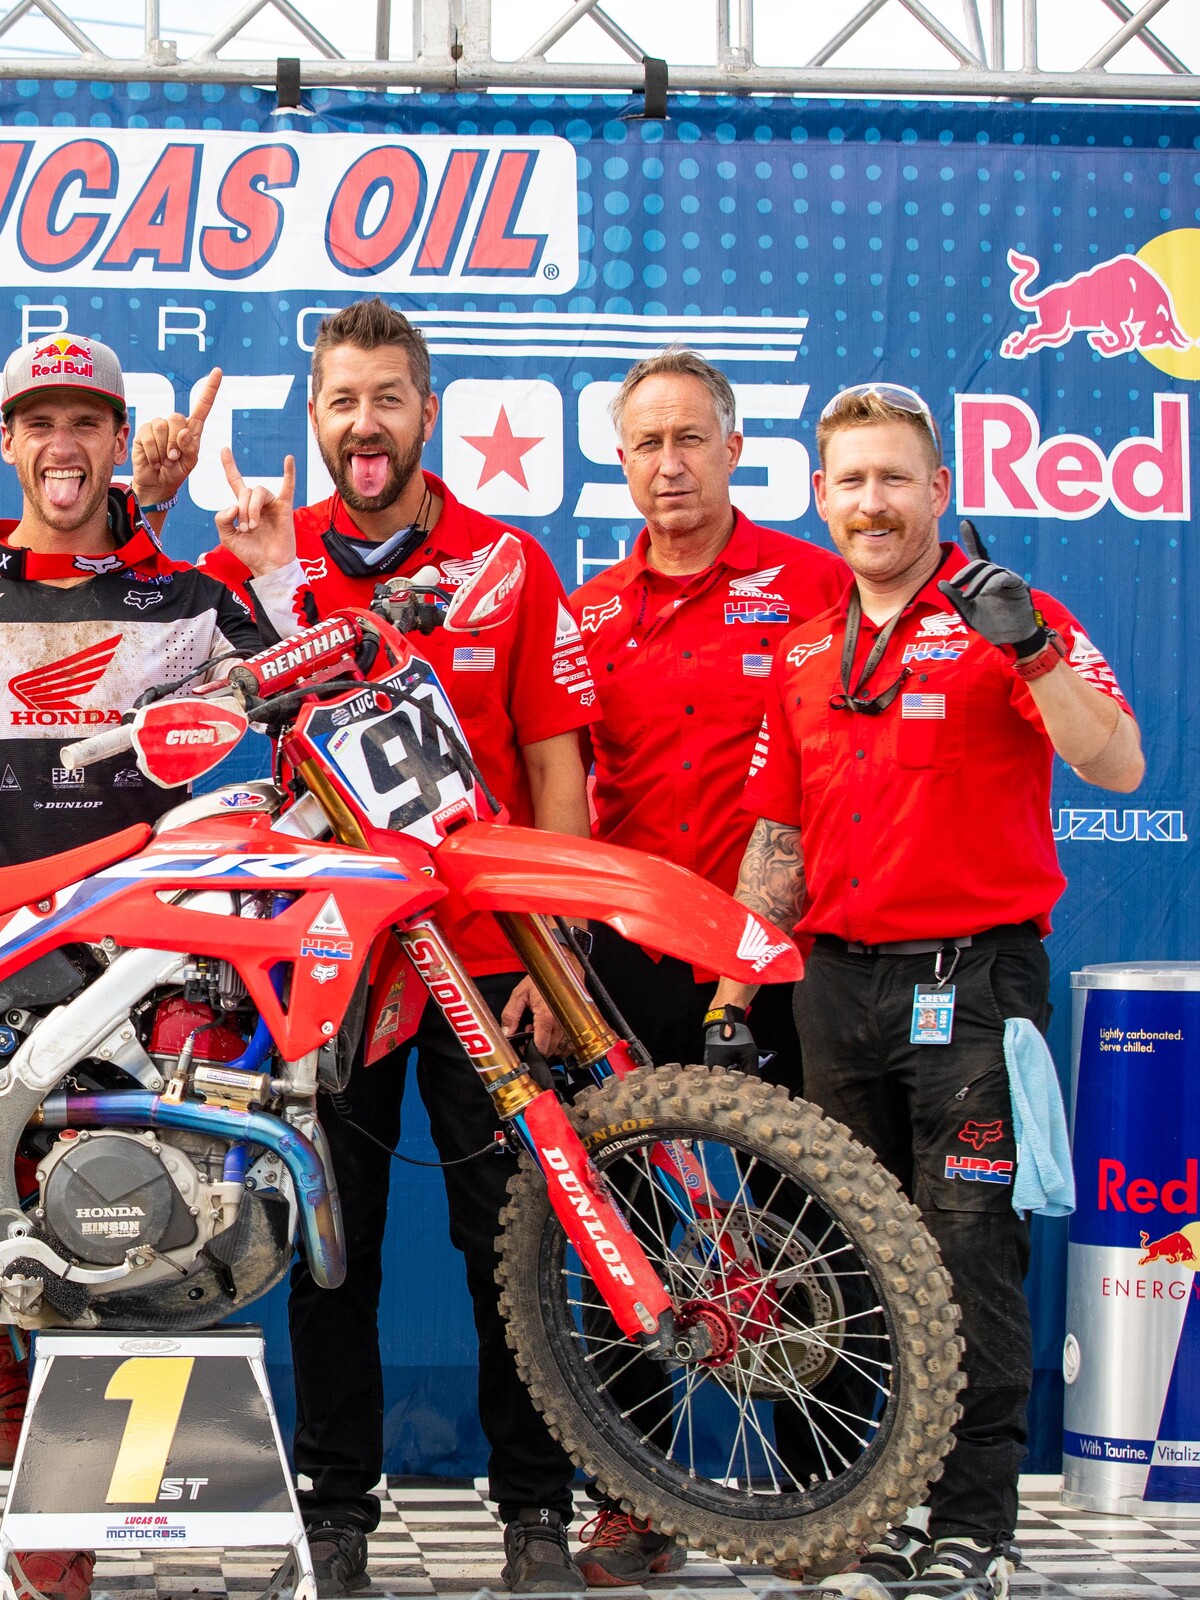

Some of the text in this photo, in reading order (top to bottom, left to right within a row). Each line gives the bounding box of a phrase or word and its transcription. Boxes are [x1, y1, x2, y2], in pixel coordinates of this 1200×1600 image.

[324, 144, 549, 278] OIL
[31, 360, 93, 379] Red Bull
[954, 393, 1191, 522] Red
[728, 590, 785, 601] HONDA
[723, 601, 790, 625] HRC
[260, 624, 356, 681] RENTHAL
[901, 639, 969, 665] HRC
[350, 690, 390, 718] LUCA
[10, 710, 123, 726] HONDA
[166, 729, 216, 746] CYCRA
[360, 692, 475, 833] 94
[45, 801, 103, 810] DUNLOP
[434, 800, 470, 823] HONDA
[1052, 809, 1186, 841] UZUKI
[94, 853, 408, 879] CRF
[300, 937, 353, 961] HRC
[751, 942, 792, 973] HONDA
[404, 937, 496, 1059] SHOWA
[917, 993, 951, 1003] CREW
[1099, 1028, 1184, 1043] Lightly carbonated.
[1099, 1042, 1156, 1053] Serve chilled.
[581, 1117, 655, 1150] UNLOP
[944, 1155, 1014, 1185] HRC
[1098, 1158, 1198, 1214] Red
[75, 1206, 146, 1219] HONDA
[542, 1146, 635, 1287] DUNLOP
[81, 1221, 140, 1233] HINSON
[1102, 1278, 1200, 1300] ENERGY
[1080, 1438, 1148, 1460] With Taurine.
[125, 1517, 153, 1525] LUCAS
[106, 1529, 187, 1539] MOTOCROSS
